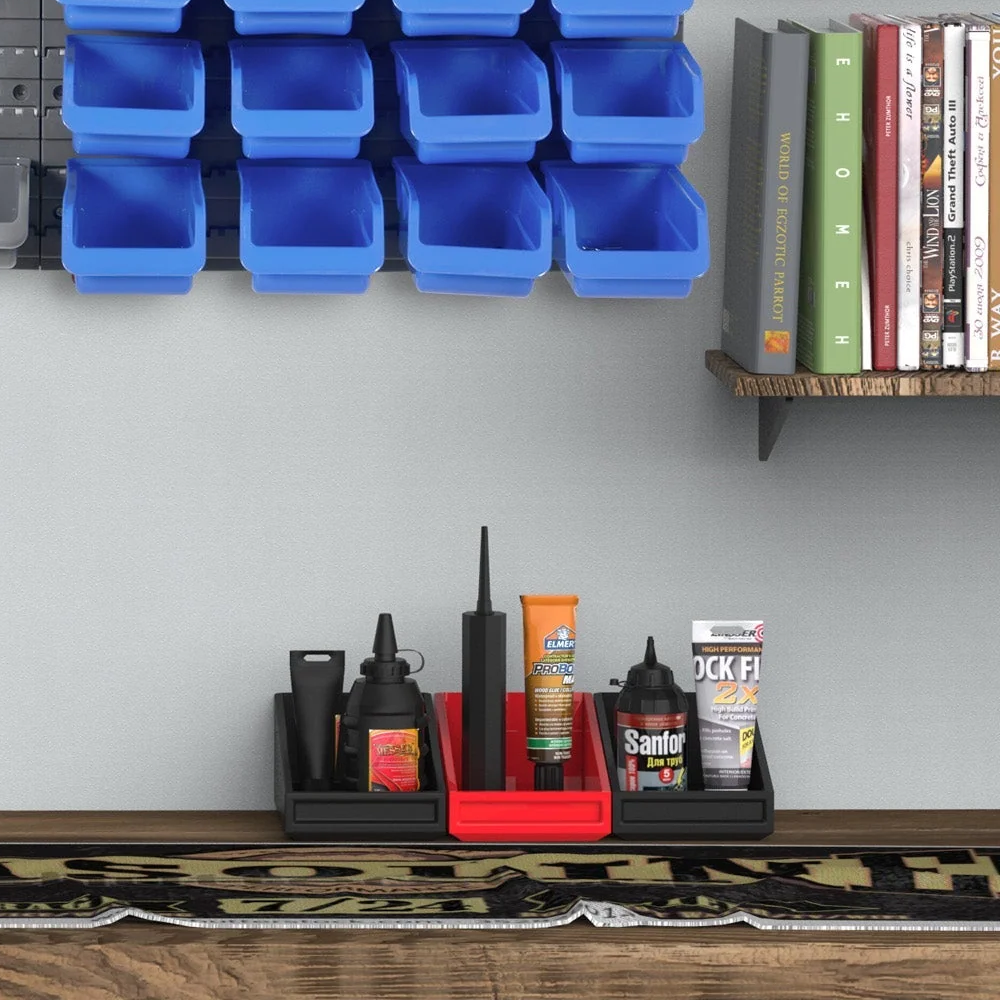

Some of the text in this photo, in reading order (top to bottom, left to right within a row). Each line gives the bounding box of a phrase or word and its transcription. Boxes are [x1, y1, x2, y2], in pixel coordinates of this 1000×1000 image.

[947, 115, 956, 150] Auto
[947, 152, 956, 181] Theft
[922, 189, 940, 217] LION
[947, 185, 956, 222] Grand
[772, 131, 791, 323] WORLD OF EGZOTIC PARROT
[922, 227, 940, 260] WIND
[905, 266, 914, 293] choice
[624, 729, 686, 756] Sanfor
[647, 757, 665, 768] Для
[663, 769, 671, 778] 5
[238, 897, 468, 913] 7/24
